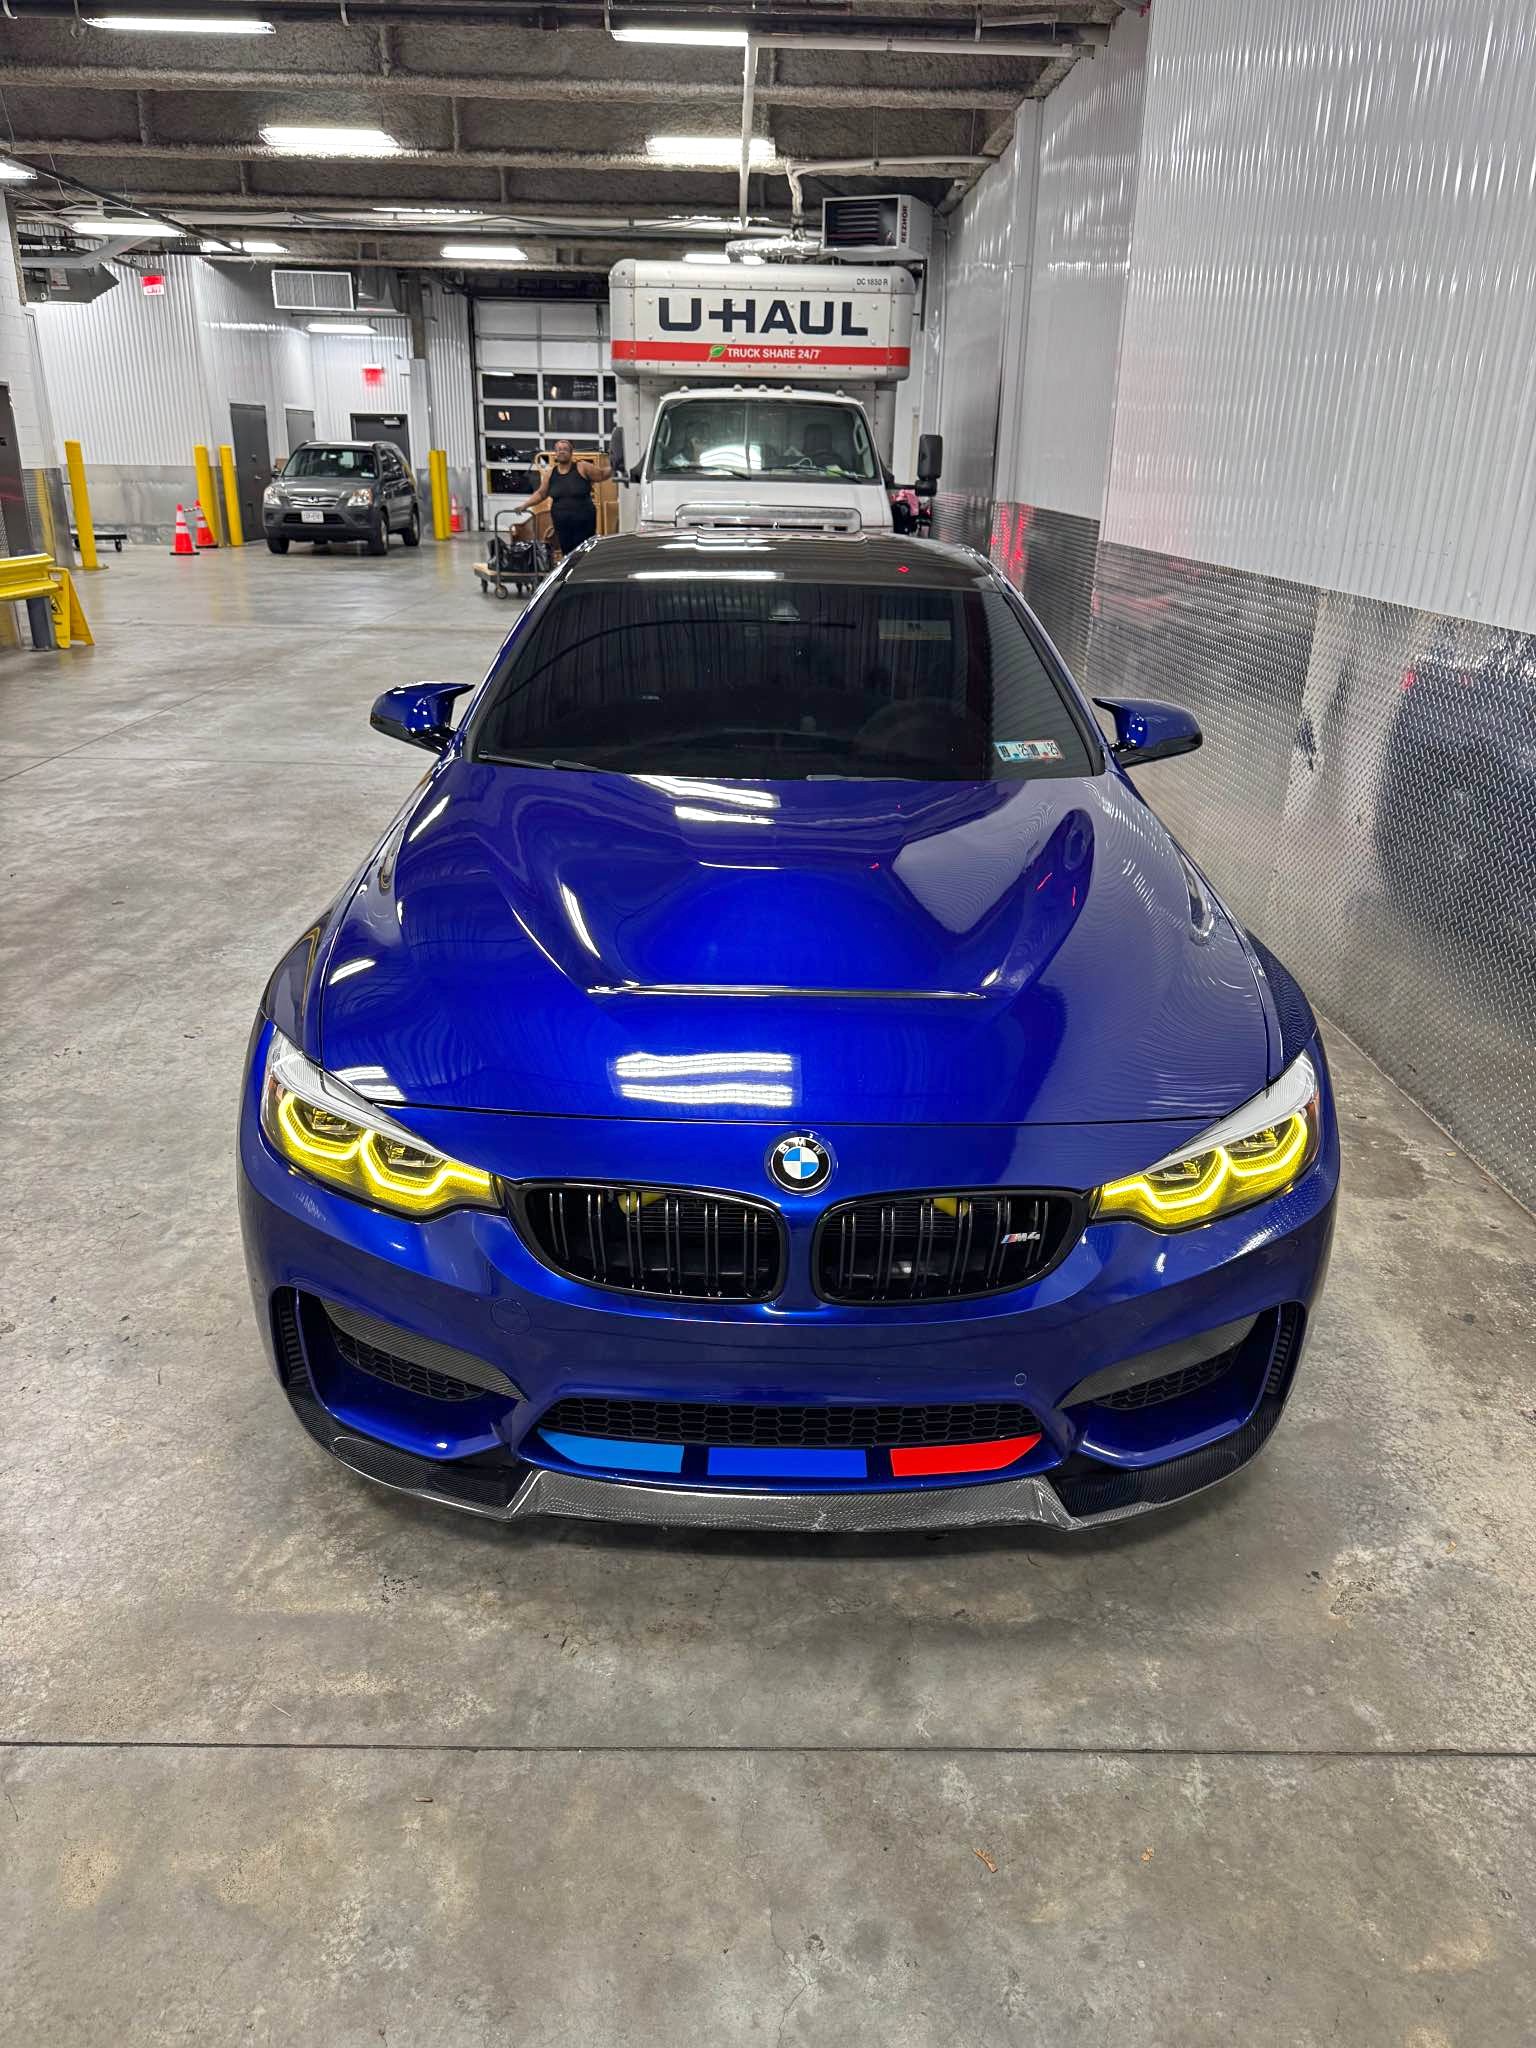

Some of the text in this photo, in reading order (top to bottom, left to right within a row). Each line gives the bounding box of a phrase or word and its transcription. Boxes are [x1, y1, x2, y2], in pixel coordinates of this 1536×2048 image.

[856, 278, 865, 286] DC
[883, 278, 889, 286] R
[658, 297, 868, 336] U-HAUL
[727, 347, 821, 360] TRUCK SHARE 24/7
[777, 1137, 825, 1154] BMW
